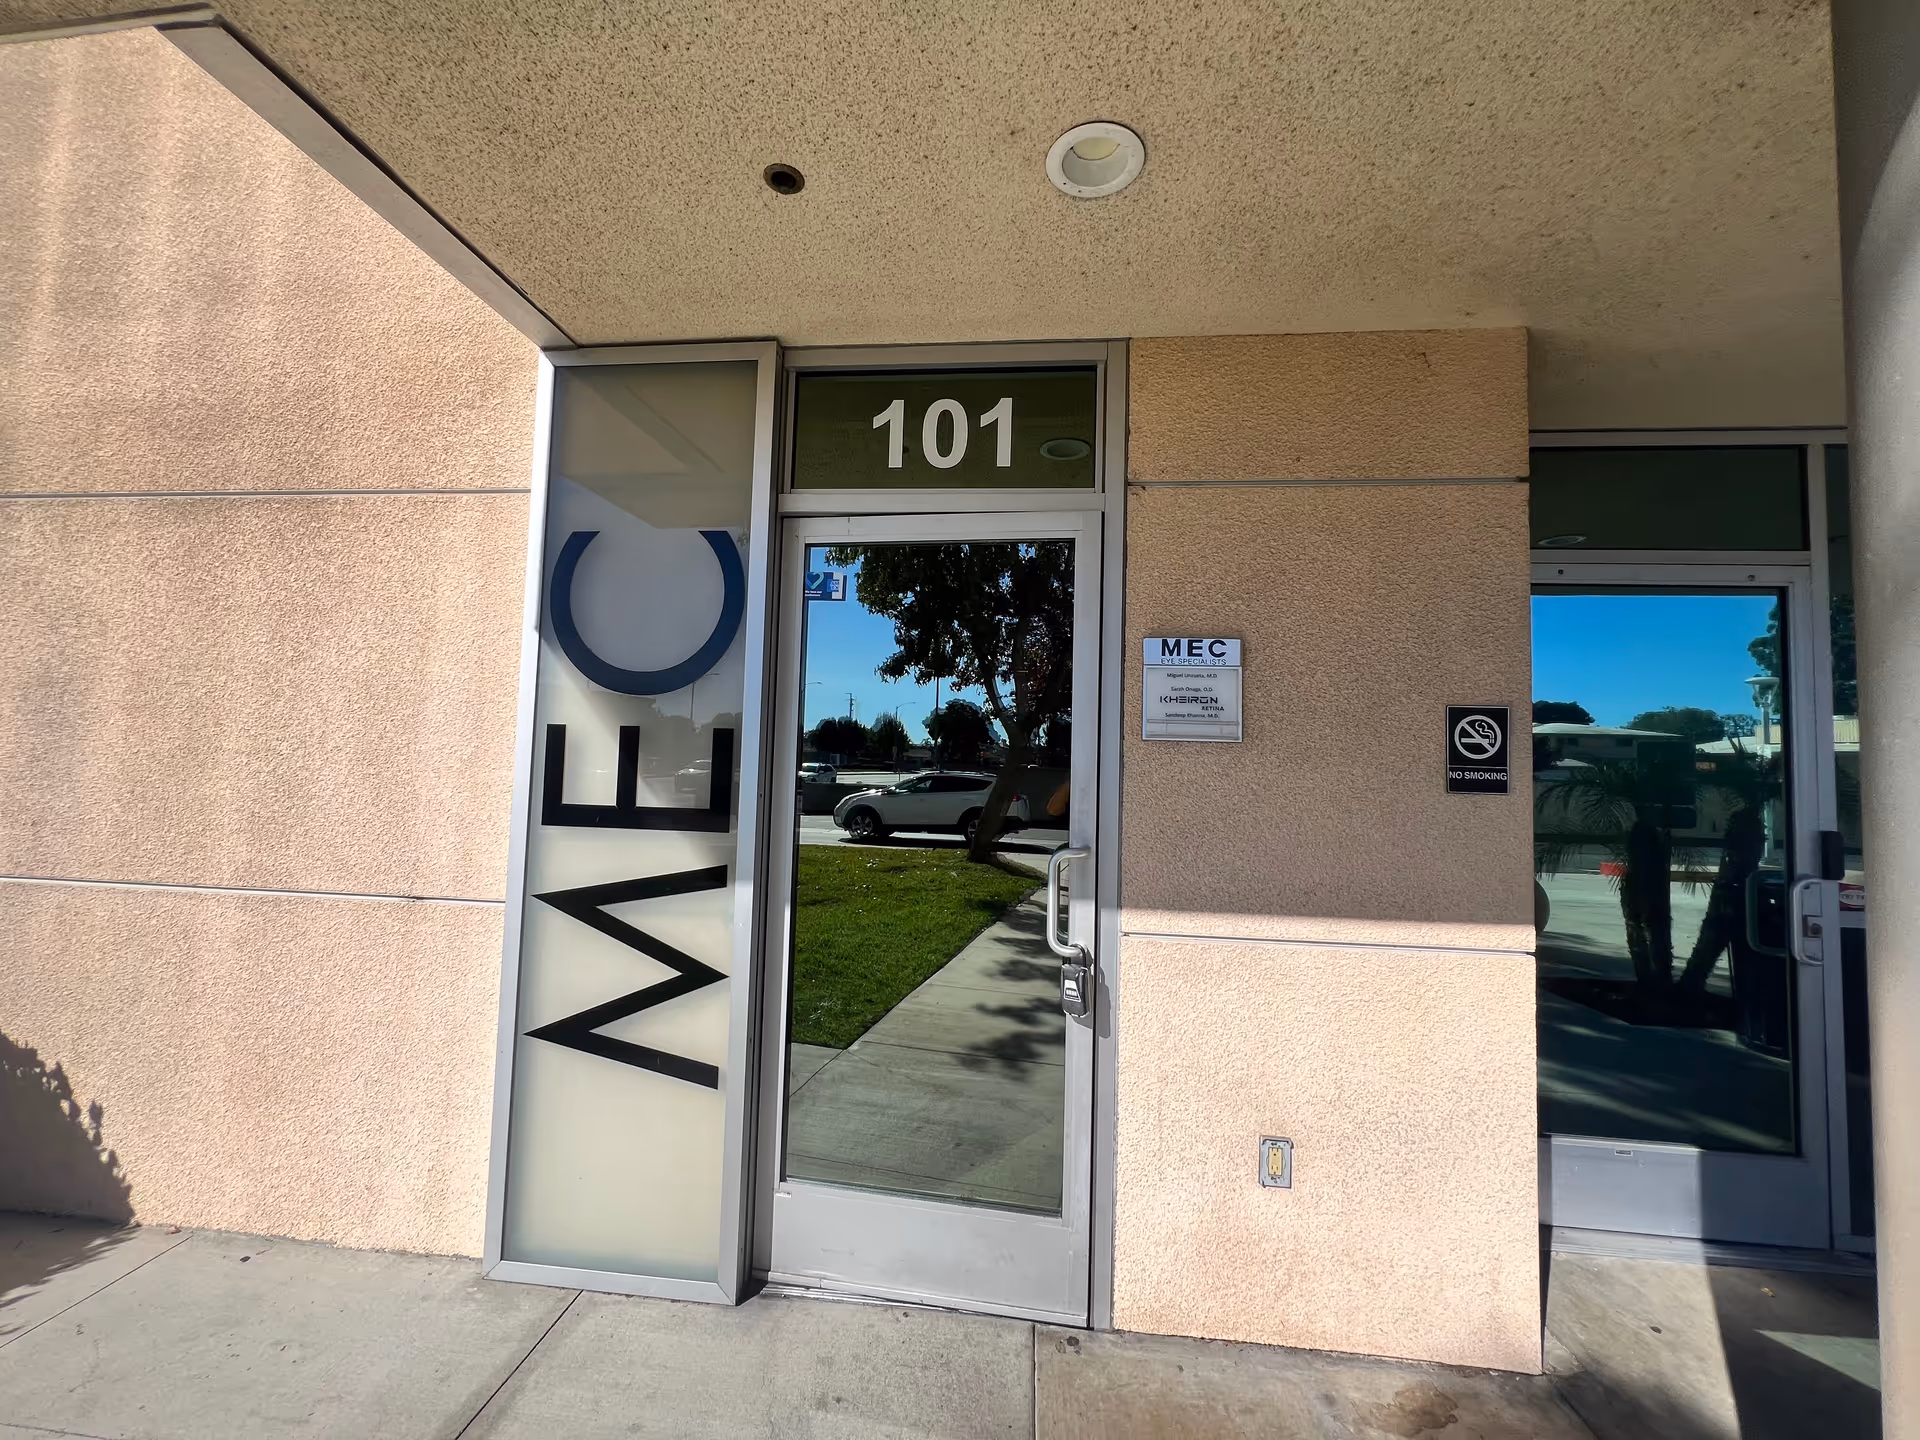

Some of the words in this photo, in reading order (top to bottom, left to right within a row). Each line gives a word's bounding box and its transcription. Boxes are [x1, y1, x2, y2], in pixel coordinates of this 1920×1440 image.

[872, 397, 1013, 469] 101
[1161, 638, 1227, 657] MEC
[1160, 695, 1218, 704] KHEIRON
[1449, 771, 1463, 779] NO
[1464, 771, 1507, 781] SMOKING
[523, 530, 745, 1090] MEC
